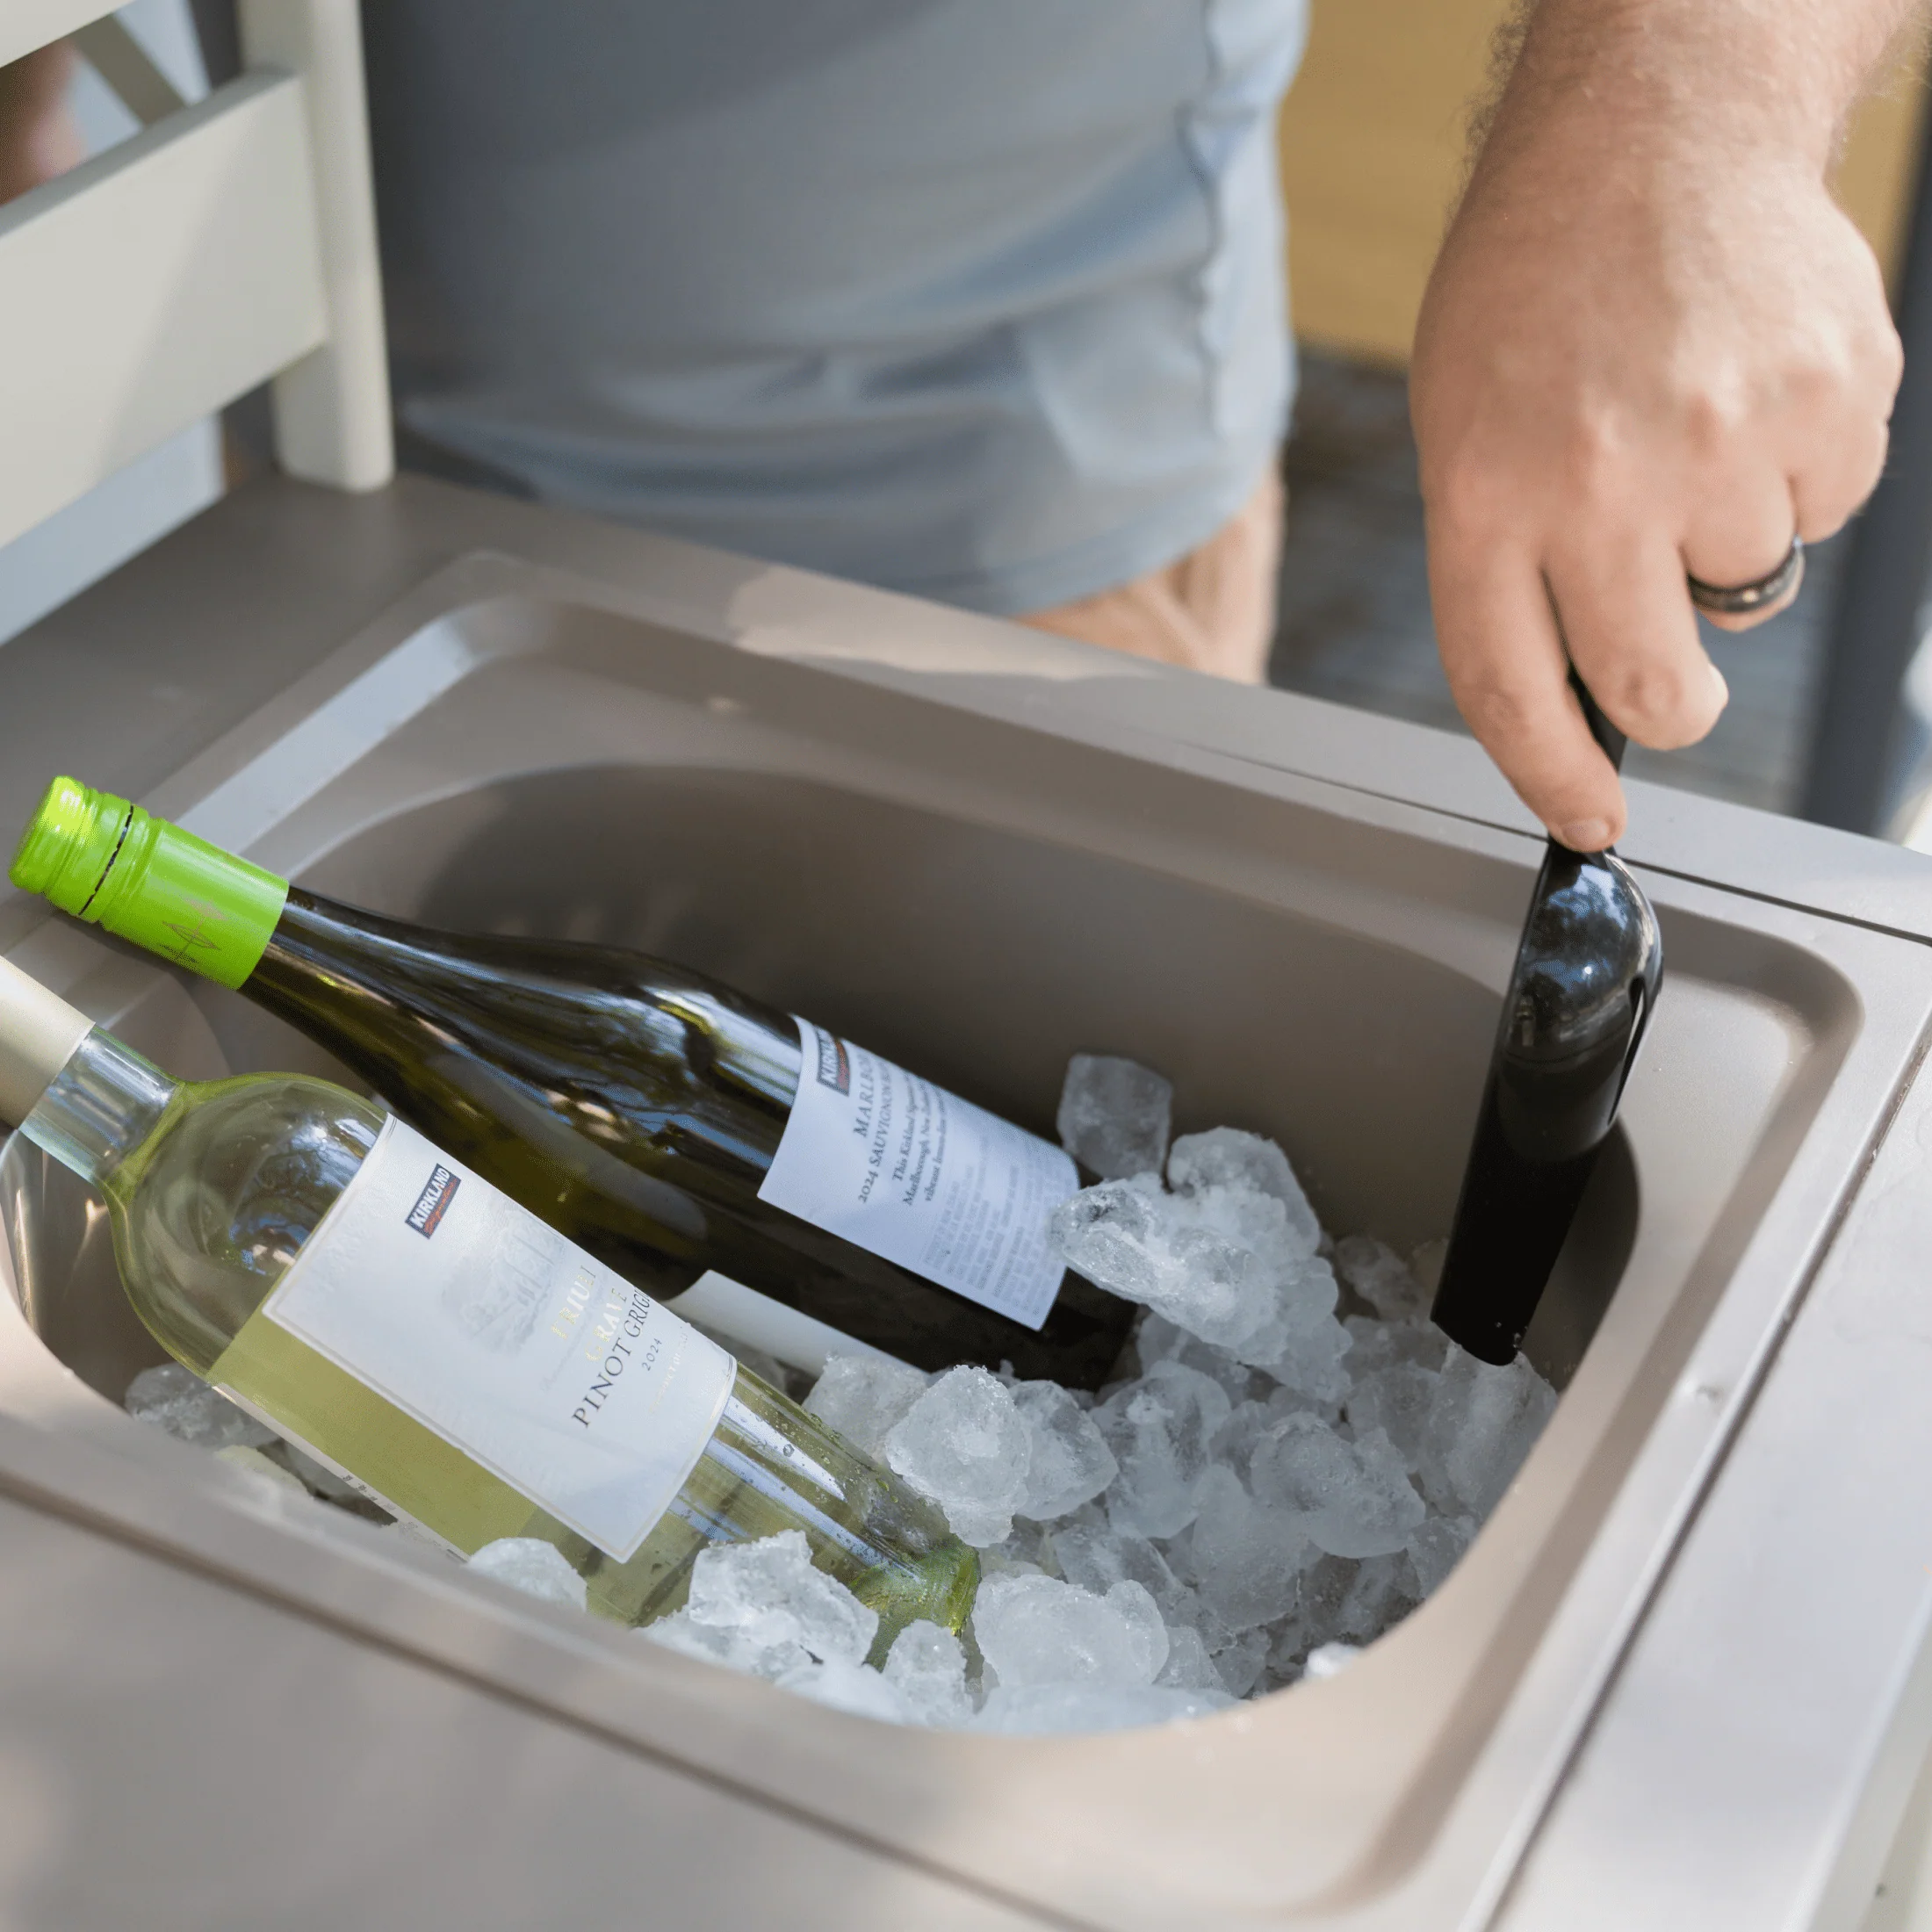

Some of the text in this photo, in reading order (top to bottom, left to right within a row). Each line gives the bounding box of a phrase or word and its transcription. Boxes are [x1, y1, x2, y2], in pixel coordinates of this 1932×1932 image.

[858, 1170, 879, 1203] 2024
[869, 1081, 893, 1167] SAUVIGNON
[892, 1158, 908, 1181] This
[409, 1167, 451, 1229] KIRKLAND
[551, 1265, 596, 1339] FRIULI
[585, 1287, 627, 1361] GRAVE
[572, 1337, 632, 1429] PINOT
[624, 1289, 651, 1338] GRIGI
[642, 1337, 662, 1371] 2024
